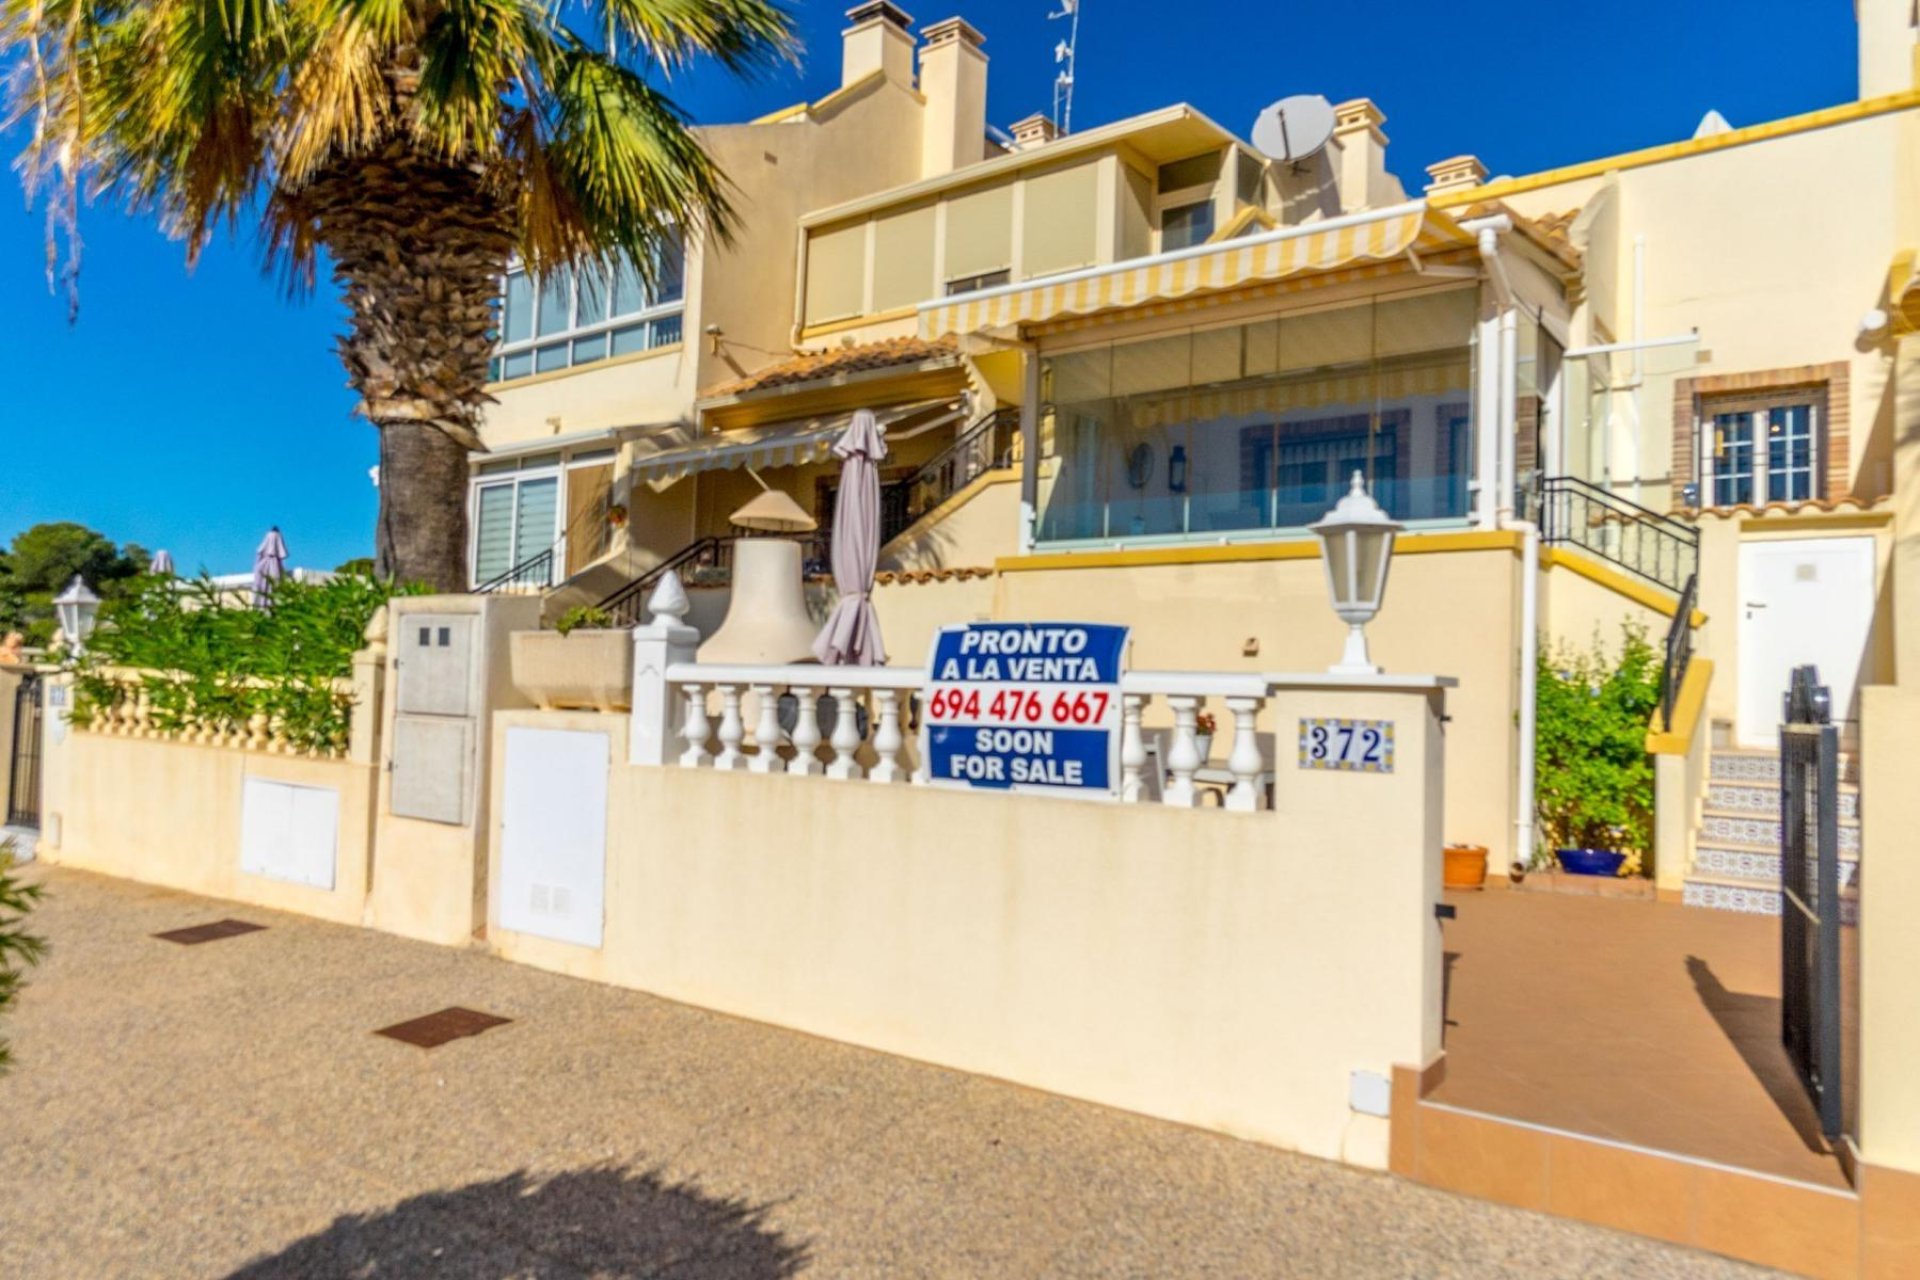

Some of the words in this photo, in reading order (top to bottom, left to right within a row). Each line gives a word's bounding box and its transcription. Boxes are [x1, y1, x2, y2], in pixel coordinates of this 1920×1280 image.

[960, 629, 1087, 654] PRONTO
[942, 659, 960, 679] A
[967, 659, 1000, 680] LA
[1008, 658, 1100, 681] VENTA
[930, 689, 980, 719] 694
[989, 691, 1042, 722] 476
[1052, 692, 1110, 724] 667
[976, 730, 1053, 754] SOON
[1312, 726, 1380, 762] 372
[951, 755, 1005, 780] FOR
[1011, 759, 1083, 785] SALE
